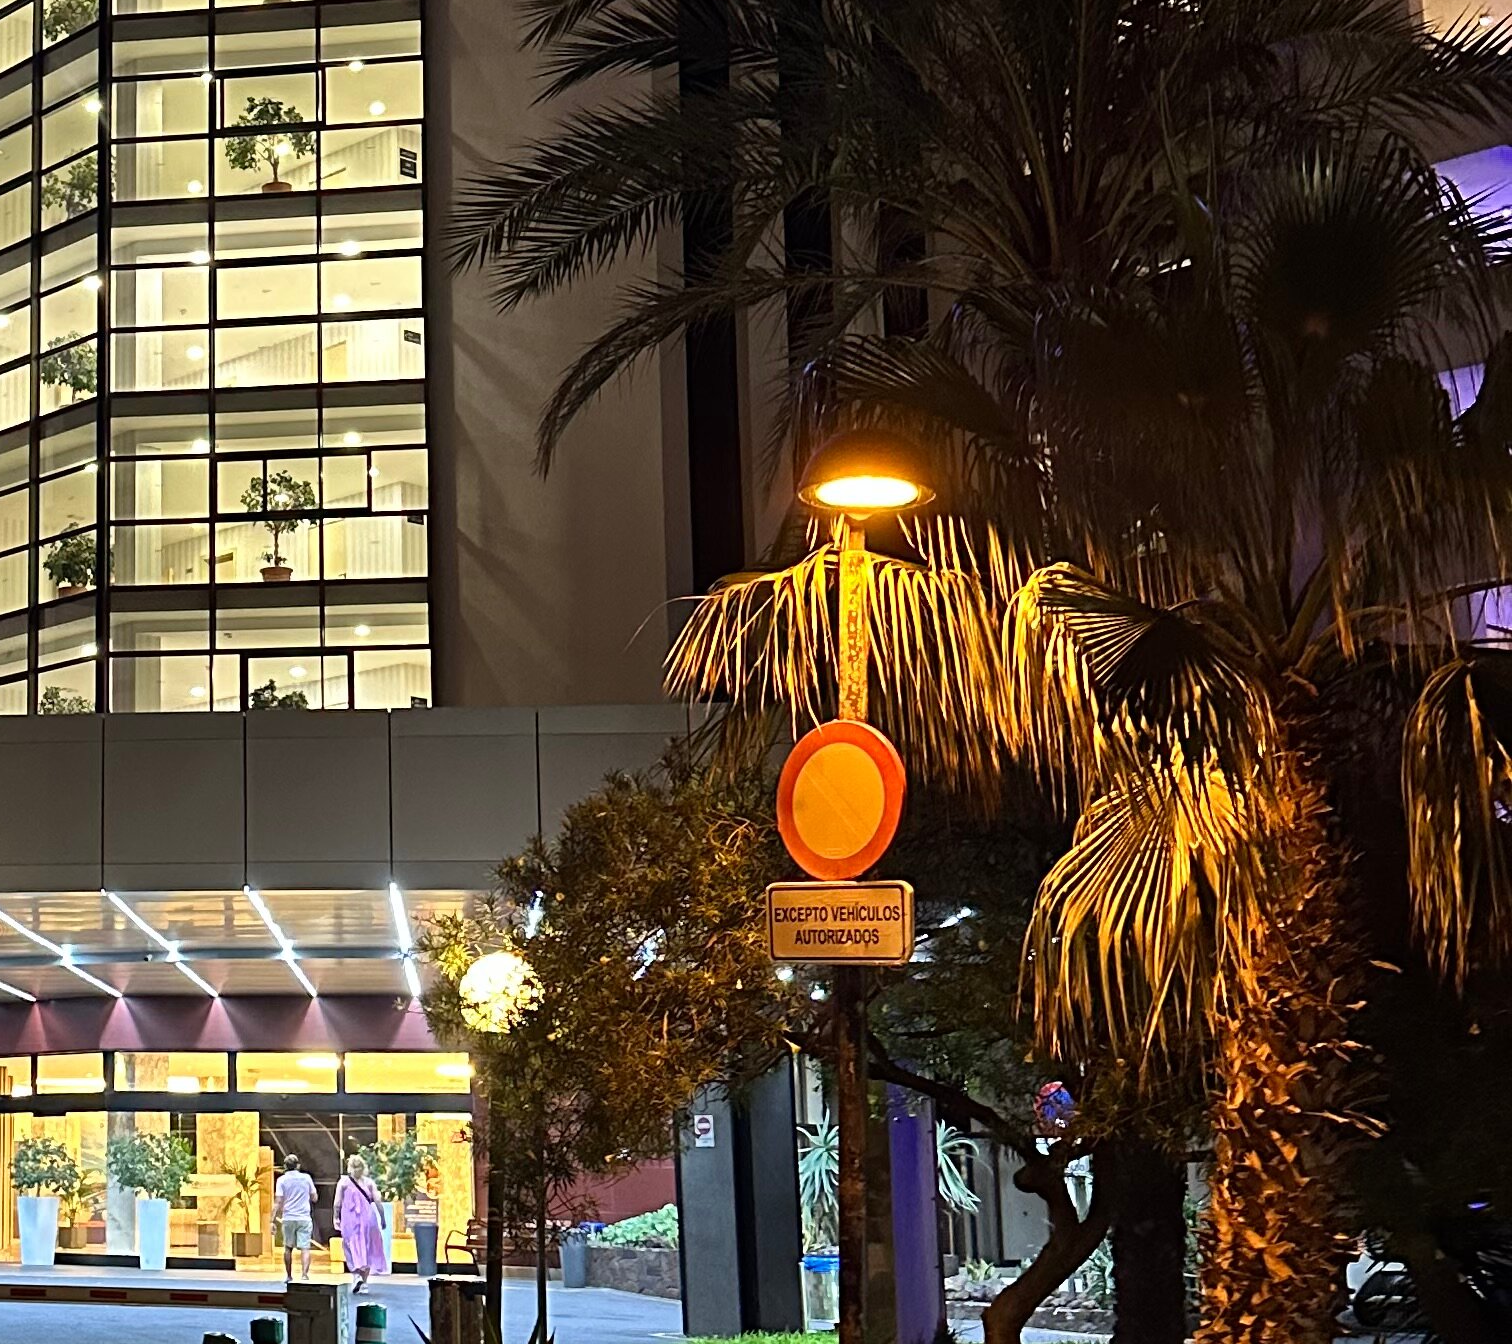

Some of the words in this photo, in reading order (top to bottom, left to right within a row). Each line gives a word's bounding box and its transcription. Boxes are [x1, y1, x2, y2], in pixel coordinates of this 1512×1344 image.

[774, 906, 828, 923] EXCEPTO
[831, 901, 901, 922] VEHÍCULOS
[794, 928, 880, 945] AUTORIZADOS
